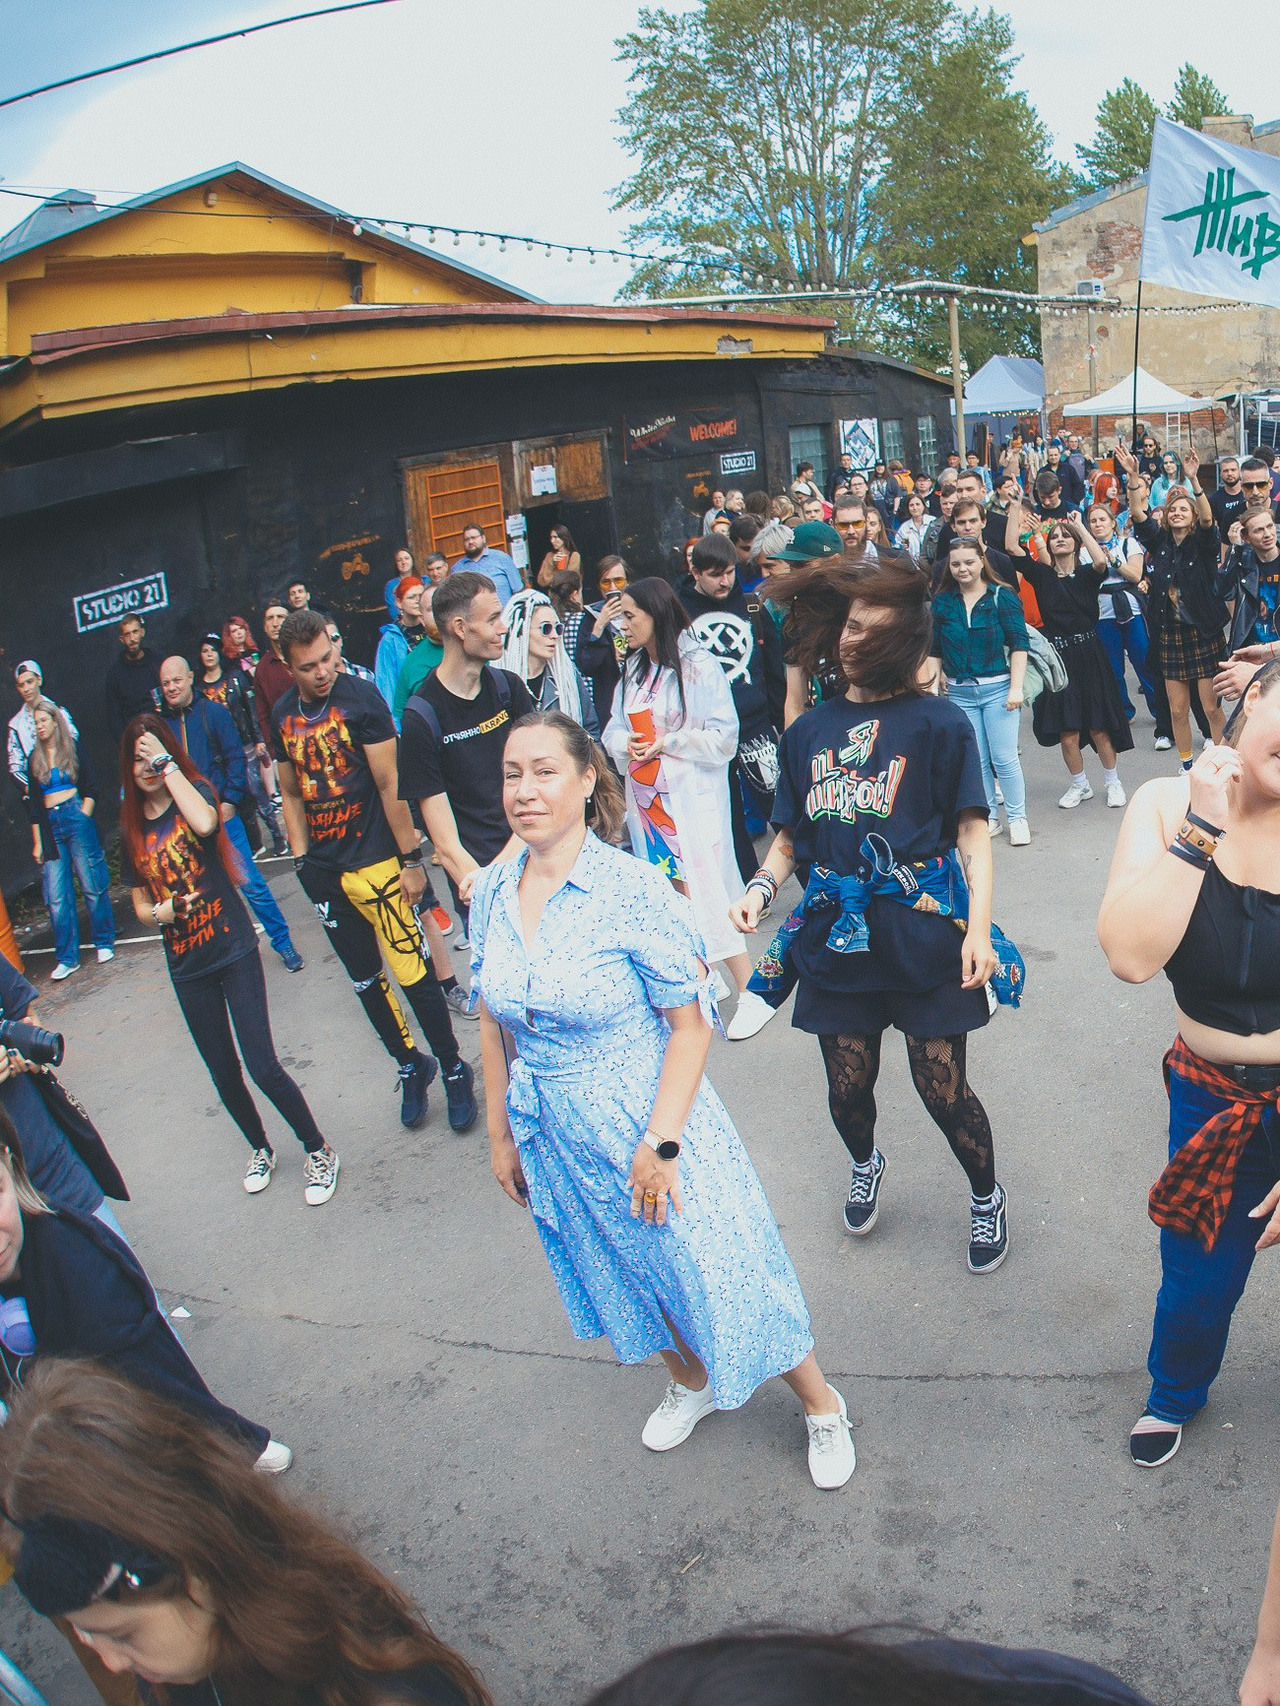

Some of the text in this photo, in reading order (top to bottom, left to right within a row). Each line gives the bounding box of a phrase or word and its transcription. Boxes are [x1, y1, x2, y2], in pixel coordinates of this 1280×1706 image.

[689, 418, 737, 441] WELCOME!
[723, 457, 746, 470] STUDIO
[82, 583, 160, 620] STUDIO 21
